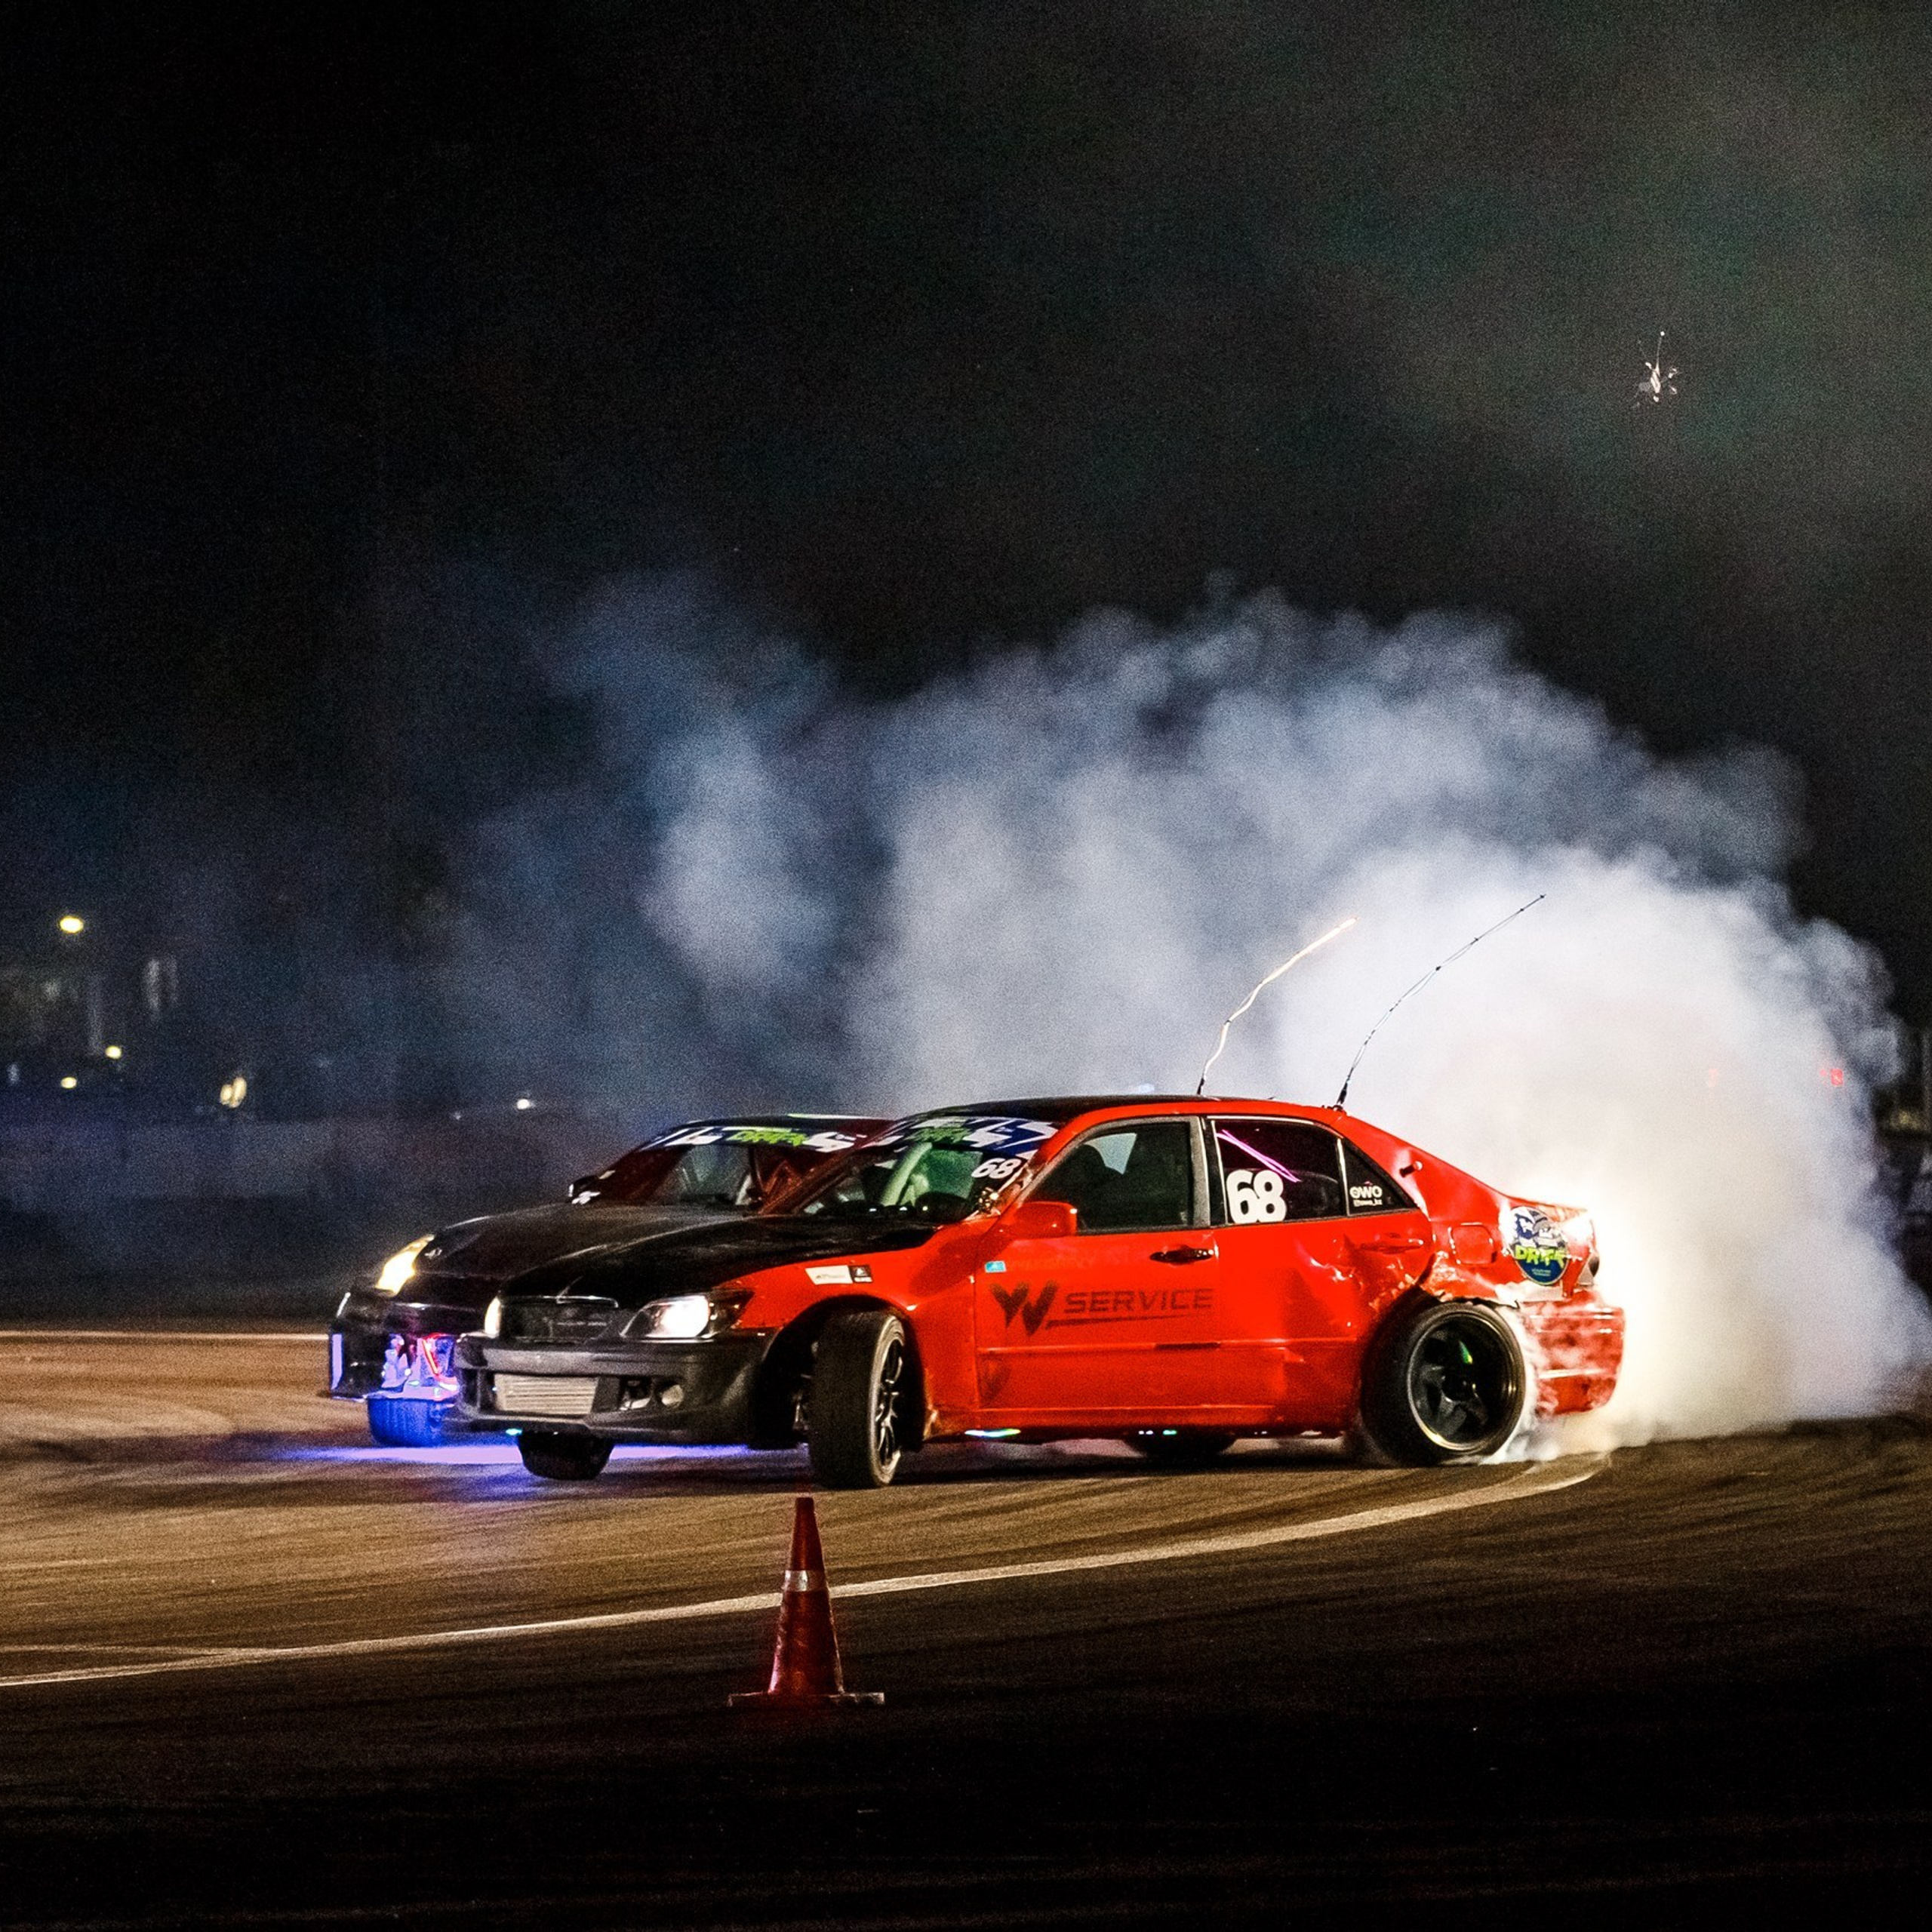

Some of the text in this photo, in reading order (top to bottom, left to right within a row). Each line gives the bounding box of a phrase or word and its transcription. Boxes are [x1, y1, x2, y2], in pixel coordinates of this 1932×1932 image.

[971, 1158, 1022, 1179] 68
[1226, 1169, 1287, 1224] 68
[1064, 1288, 1214, 1314] SERVICE
